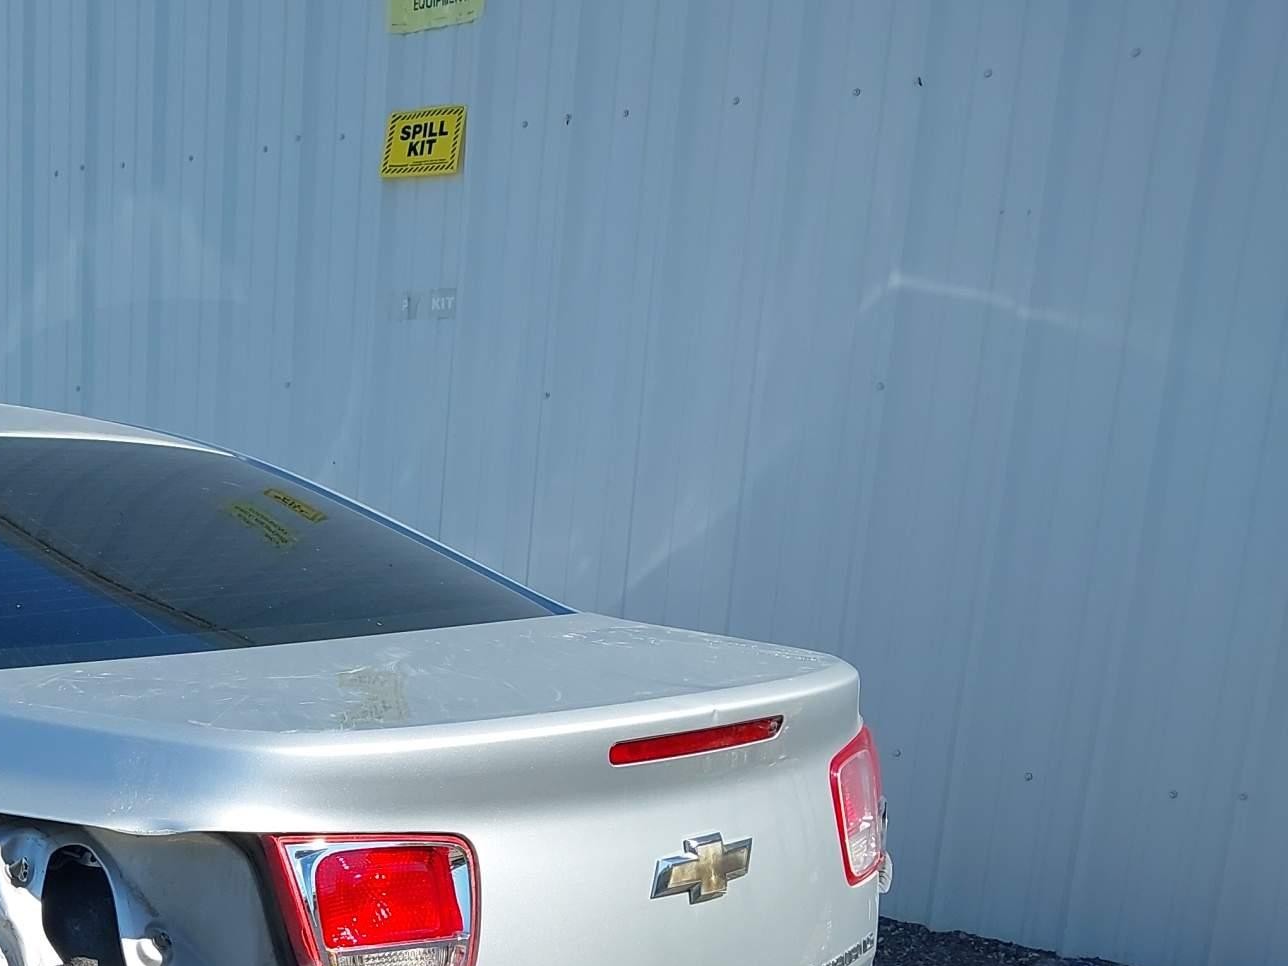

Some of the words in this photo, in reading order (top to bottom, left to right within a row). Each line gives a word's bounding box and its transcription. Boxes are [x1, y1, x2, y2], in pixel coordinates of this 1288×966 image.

[414, 0, 468, 11] EQUIP
[400, 120, 449, 141] SPILL
[407, 139, 437, 157] KIT
[432, 296, 455, 311] KIT
